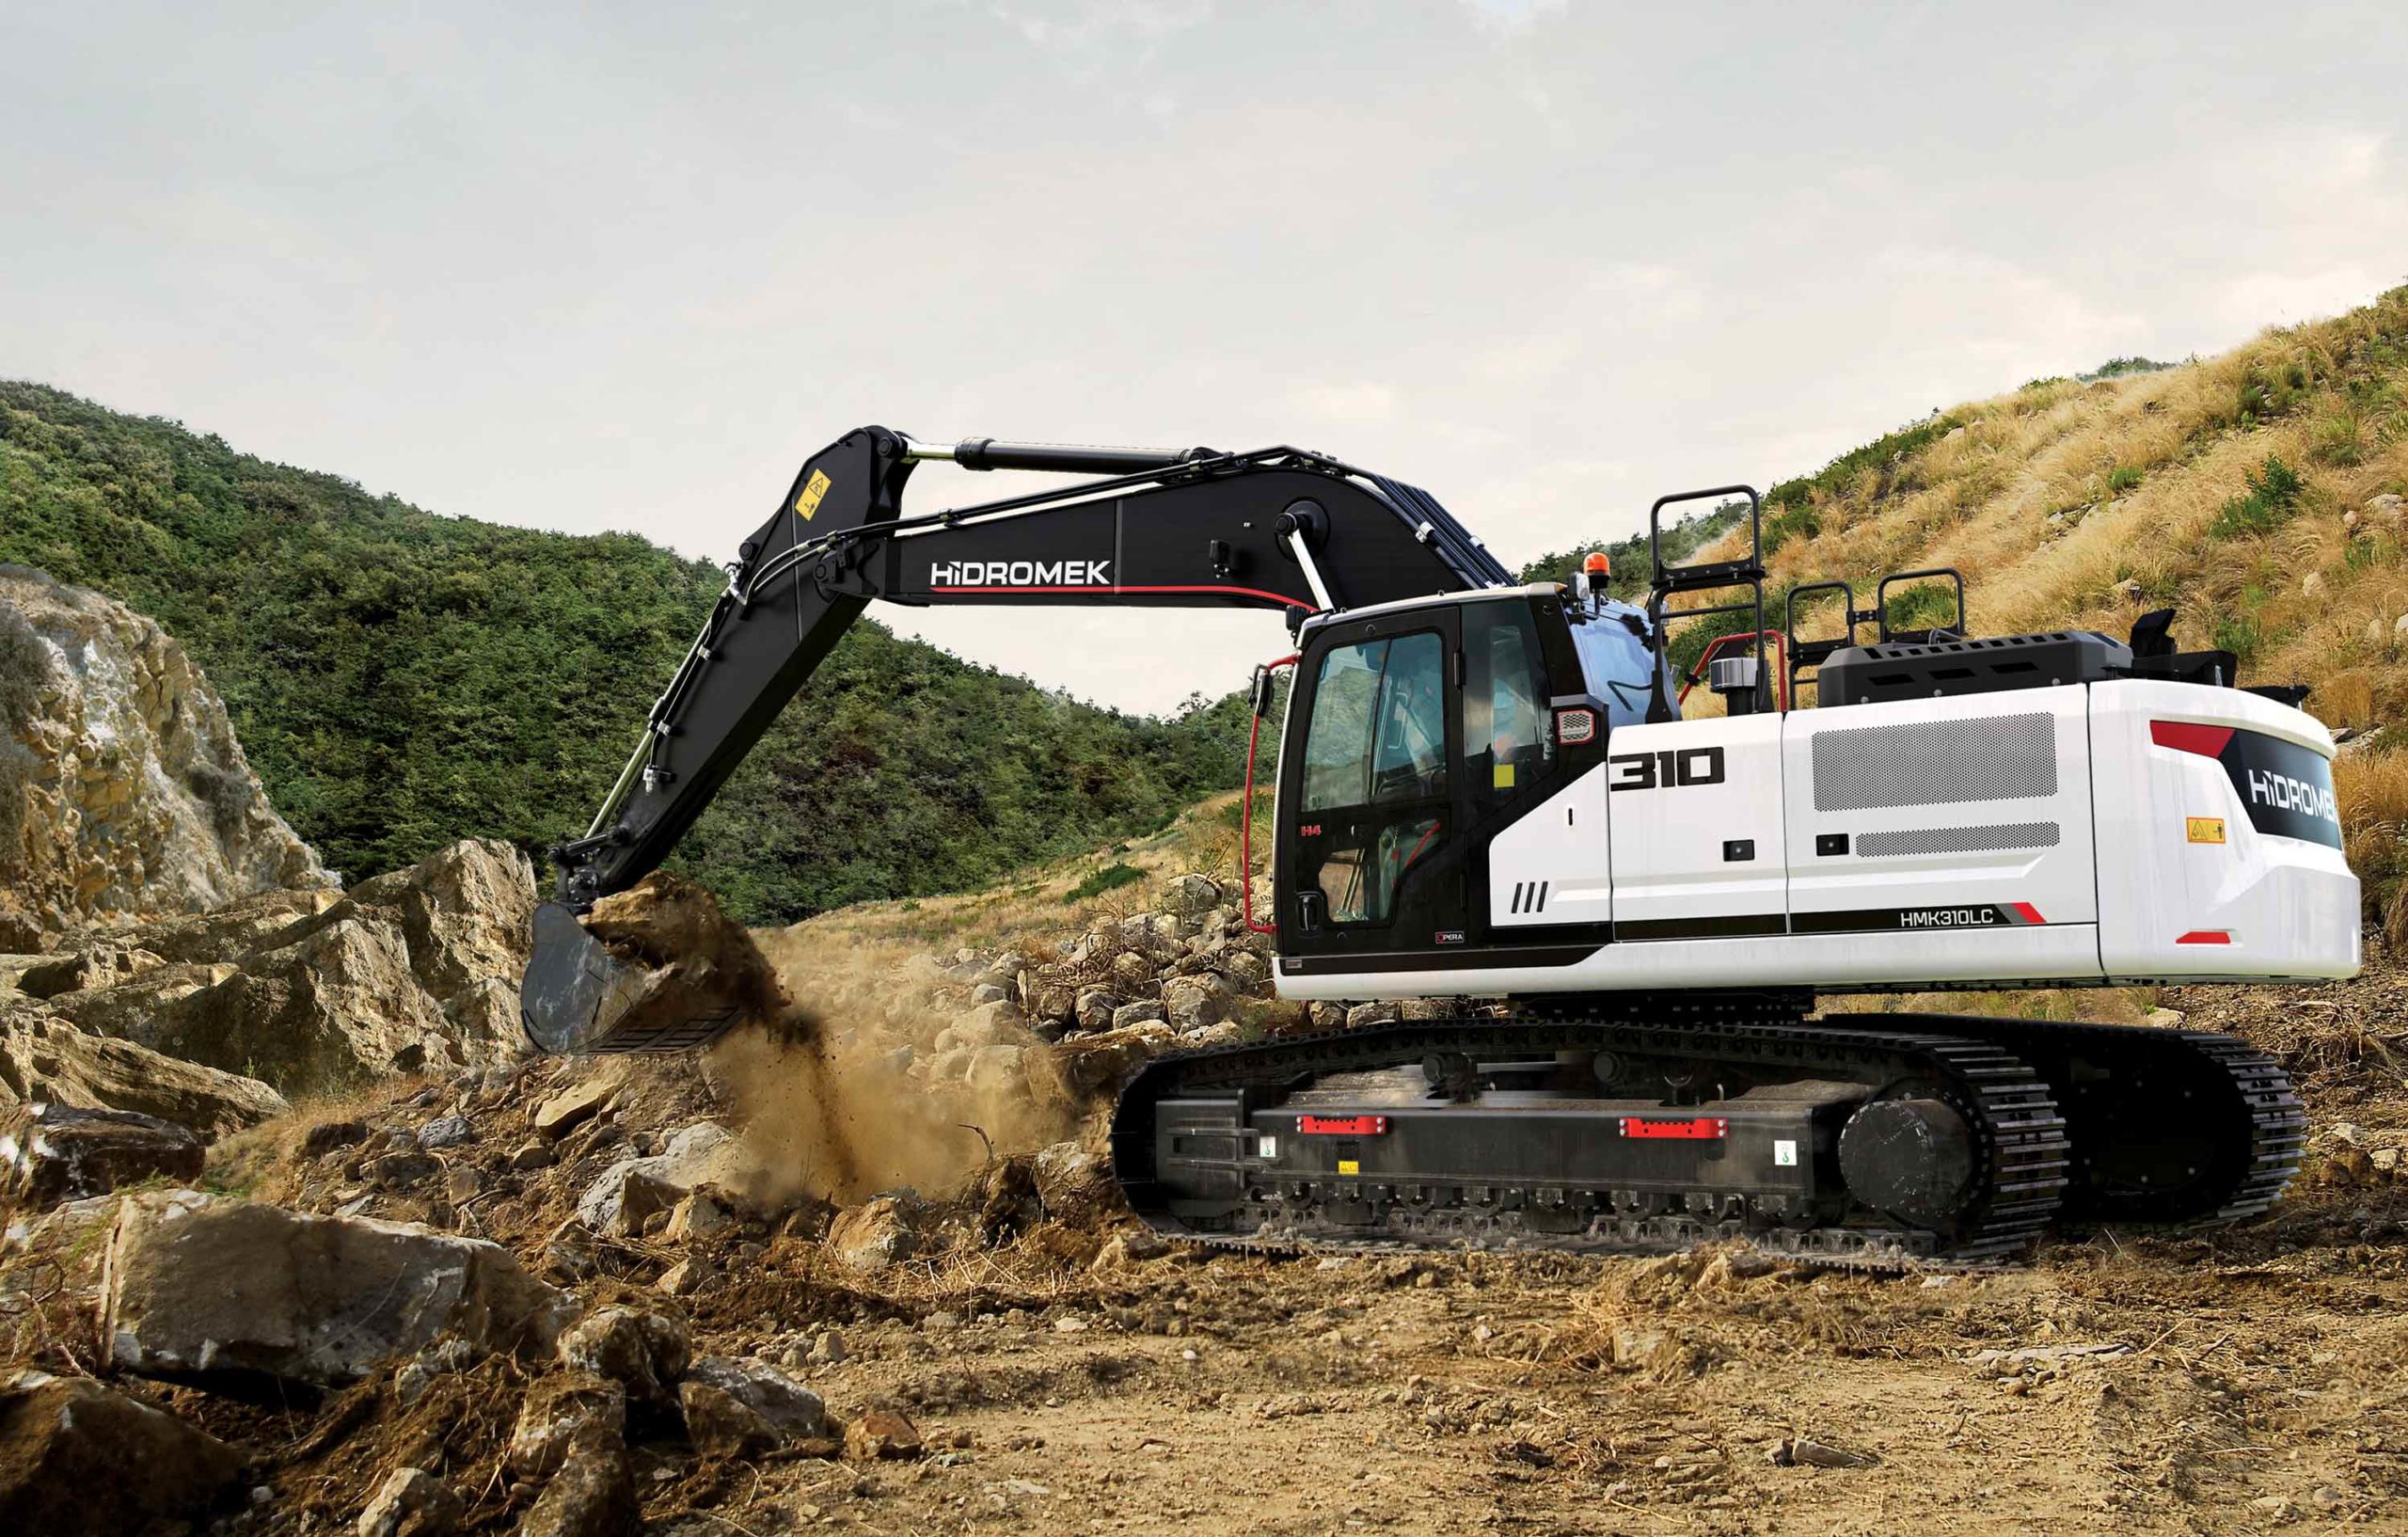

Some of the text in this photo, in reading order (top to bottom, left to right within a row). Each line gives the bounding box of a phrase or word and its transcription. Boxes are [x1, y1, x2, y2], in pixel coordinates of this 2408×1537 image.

[1609, 747, 1725, 791] 310
[1301, 825, 1322, 836] H4
[1901, 909, 1994, 927] HMK310LC
